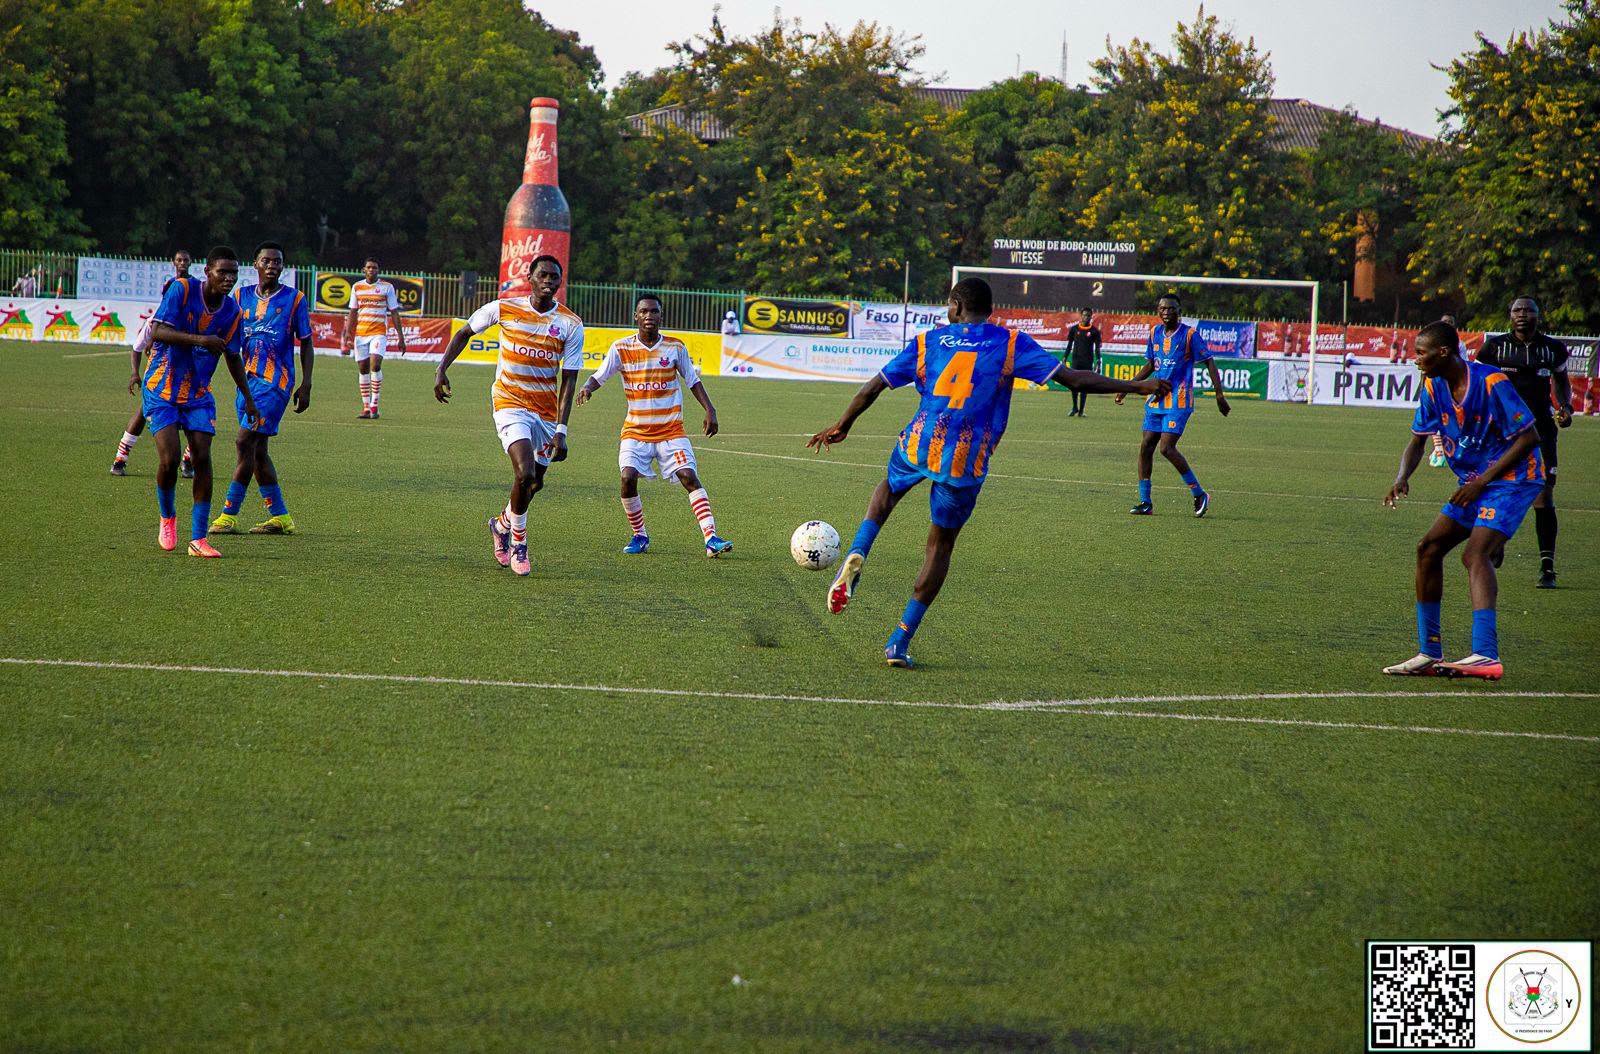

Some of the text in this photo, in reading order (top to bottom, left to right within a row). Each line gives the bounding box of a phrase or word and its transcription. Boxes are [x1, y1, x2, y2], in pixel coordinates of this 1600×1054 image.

[502, 233, 544, 261] World
[993, 238, 1136, 253] STADE WOBI DE BOBO-DIOULASSO
[1010, 251, 1044, 265] VITESSE
[1021, 280, 1104, 297] 1 2
[779, 309, 845, 325] SANNUSO
[866, 309, 899, 324] Faso
[1006, 318, 1044, 326] BASCULE
[1112, 324, 1151, 332] BASCULE
[513, 341, 554, 360] Lonab
[812, 344, 849, 354] BANQUE
[1566, 343, 1593, 357] rale
[631, 379, 668, 392] Lonab
[932, 351, 979, 410] 4
[674, 450, 688, 465] 11
[1478, 507, 1496, 520] 23
